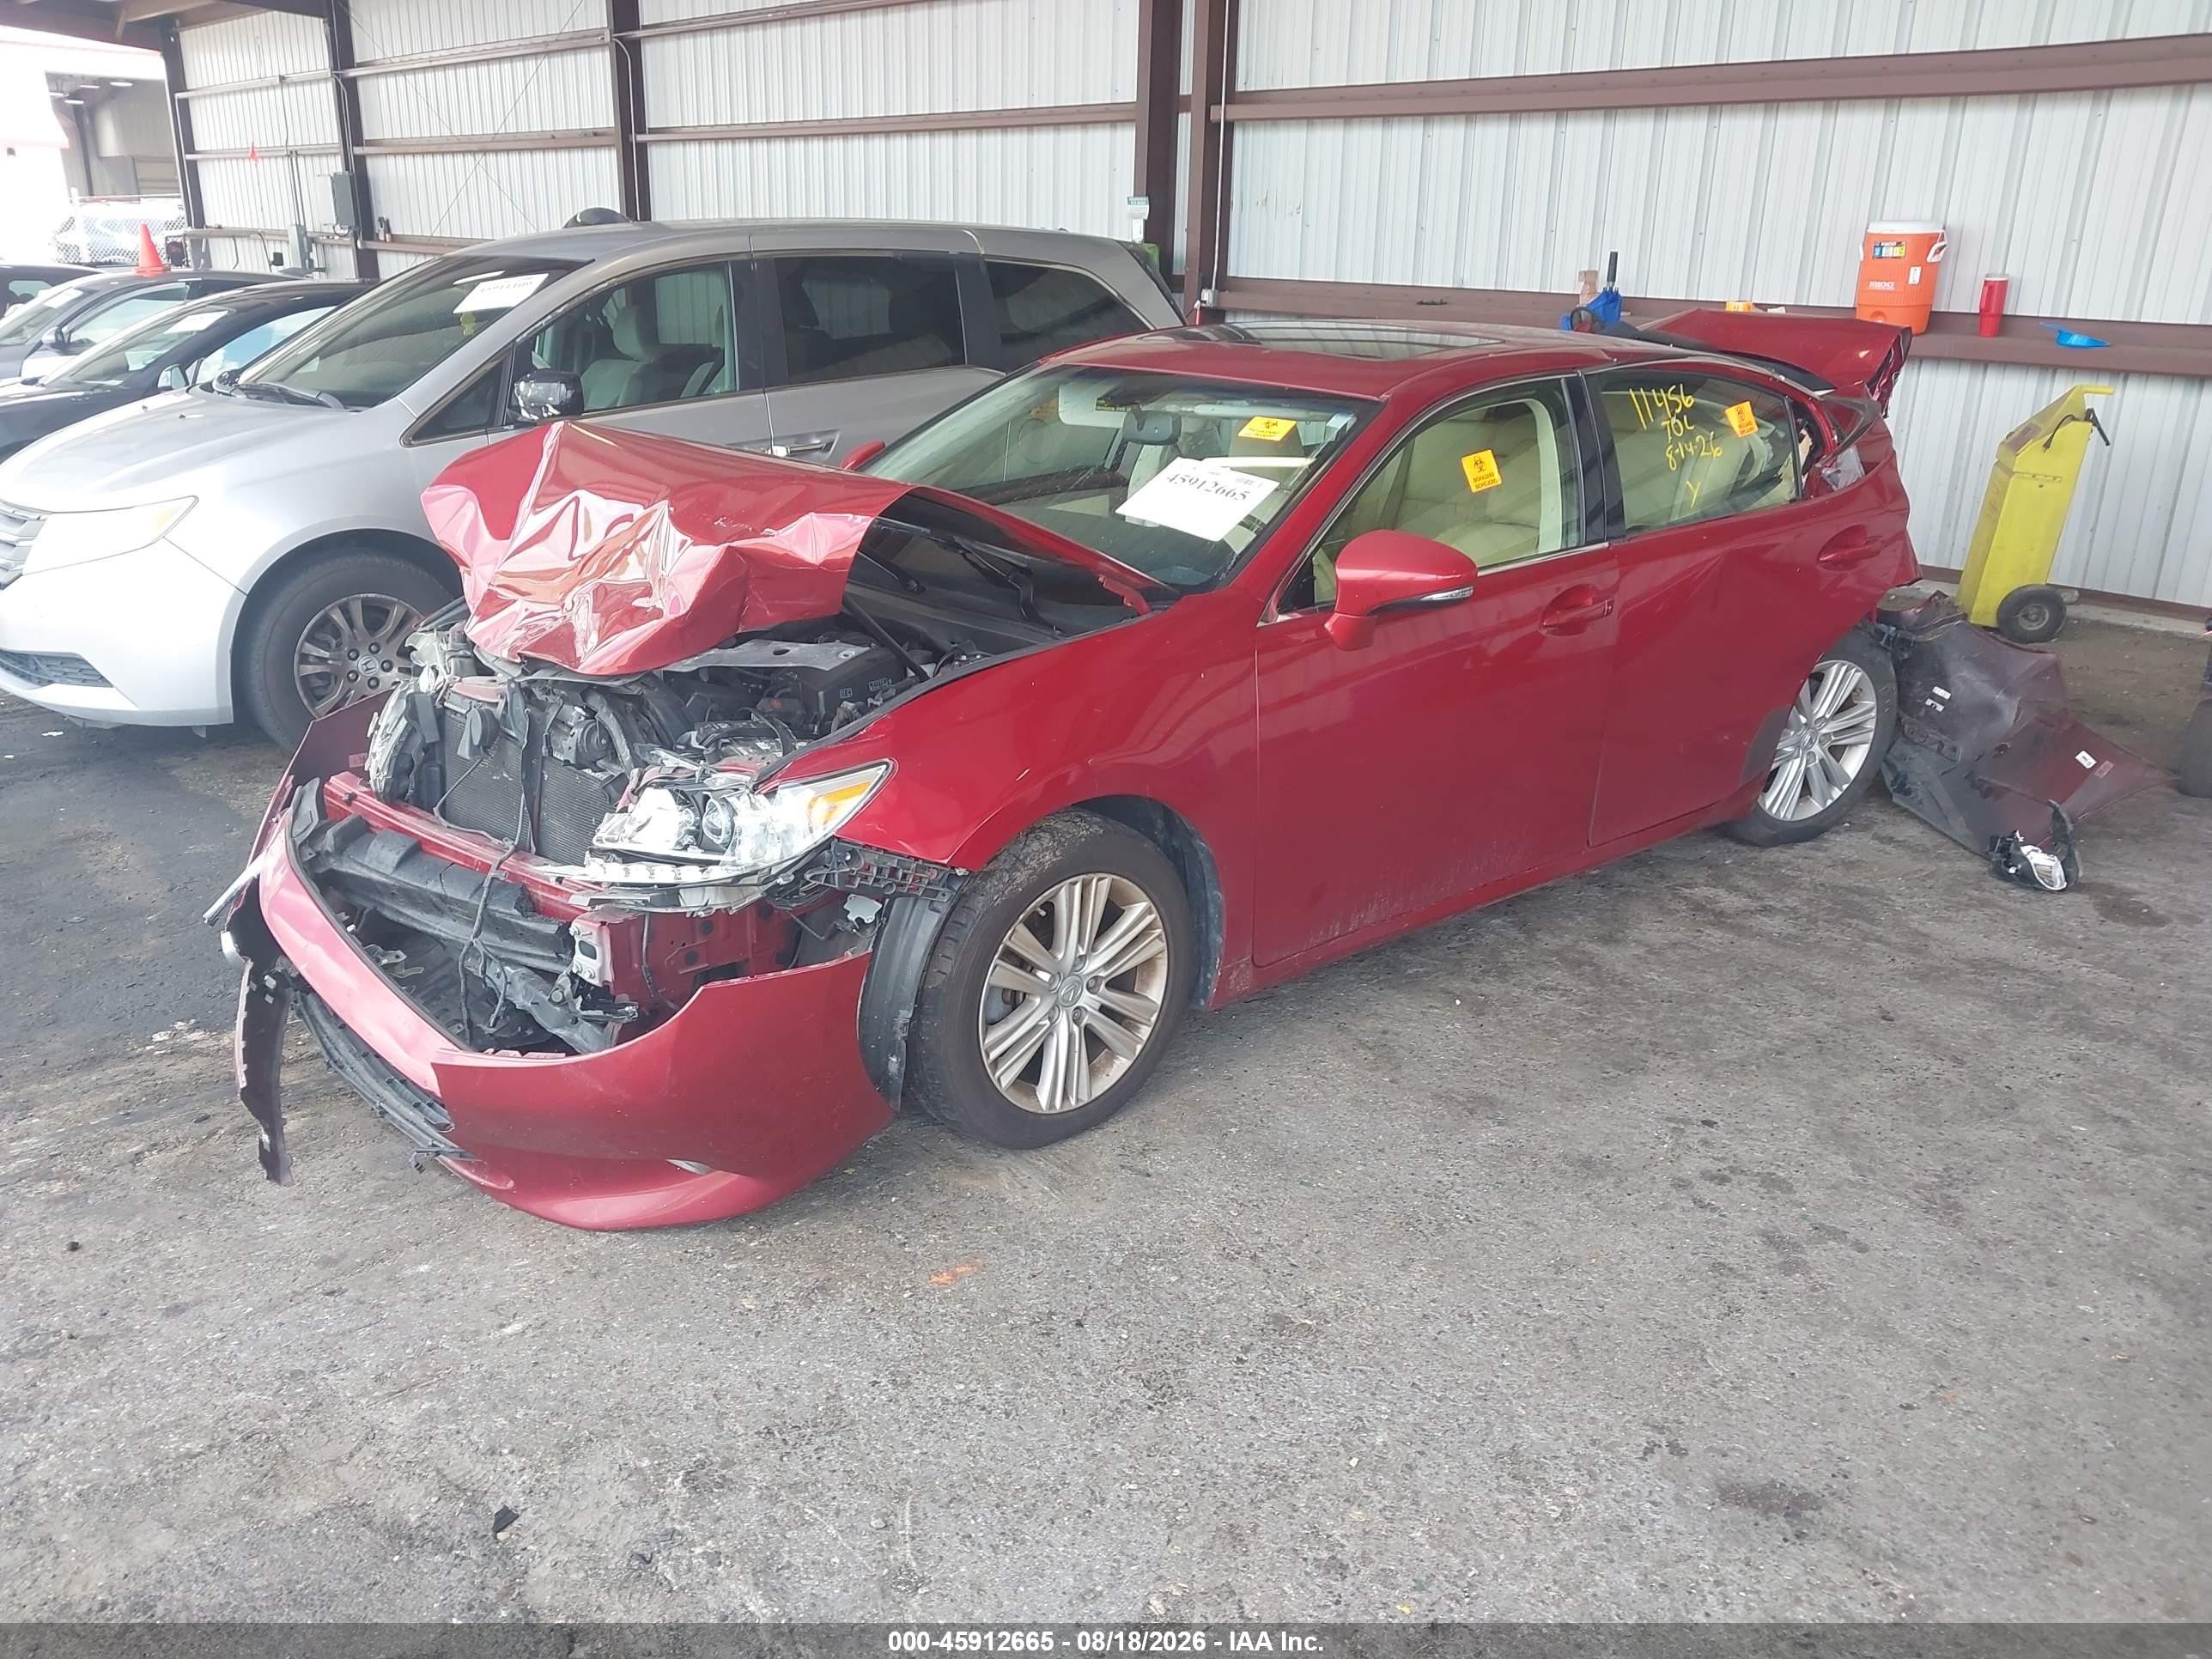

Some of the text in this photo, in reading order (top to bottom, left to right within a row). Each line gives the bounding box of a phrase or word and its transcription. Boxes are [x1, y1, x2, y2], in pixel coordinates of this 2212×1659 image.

[1629, 383, 1695, 430] 11456
[1167, 473, 1251, 501] 45912665
[1686, 480, 1701, 509] Y
